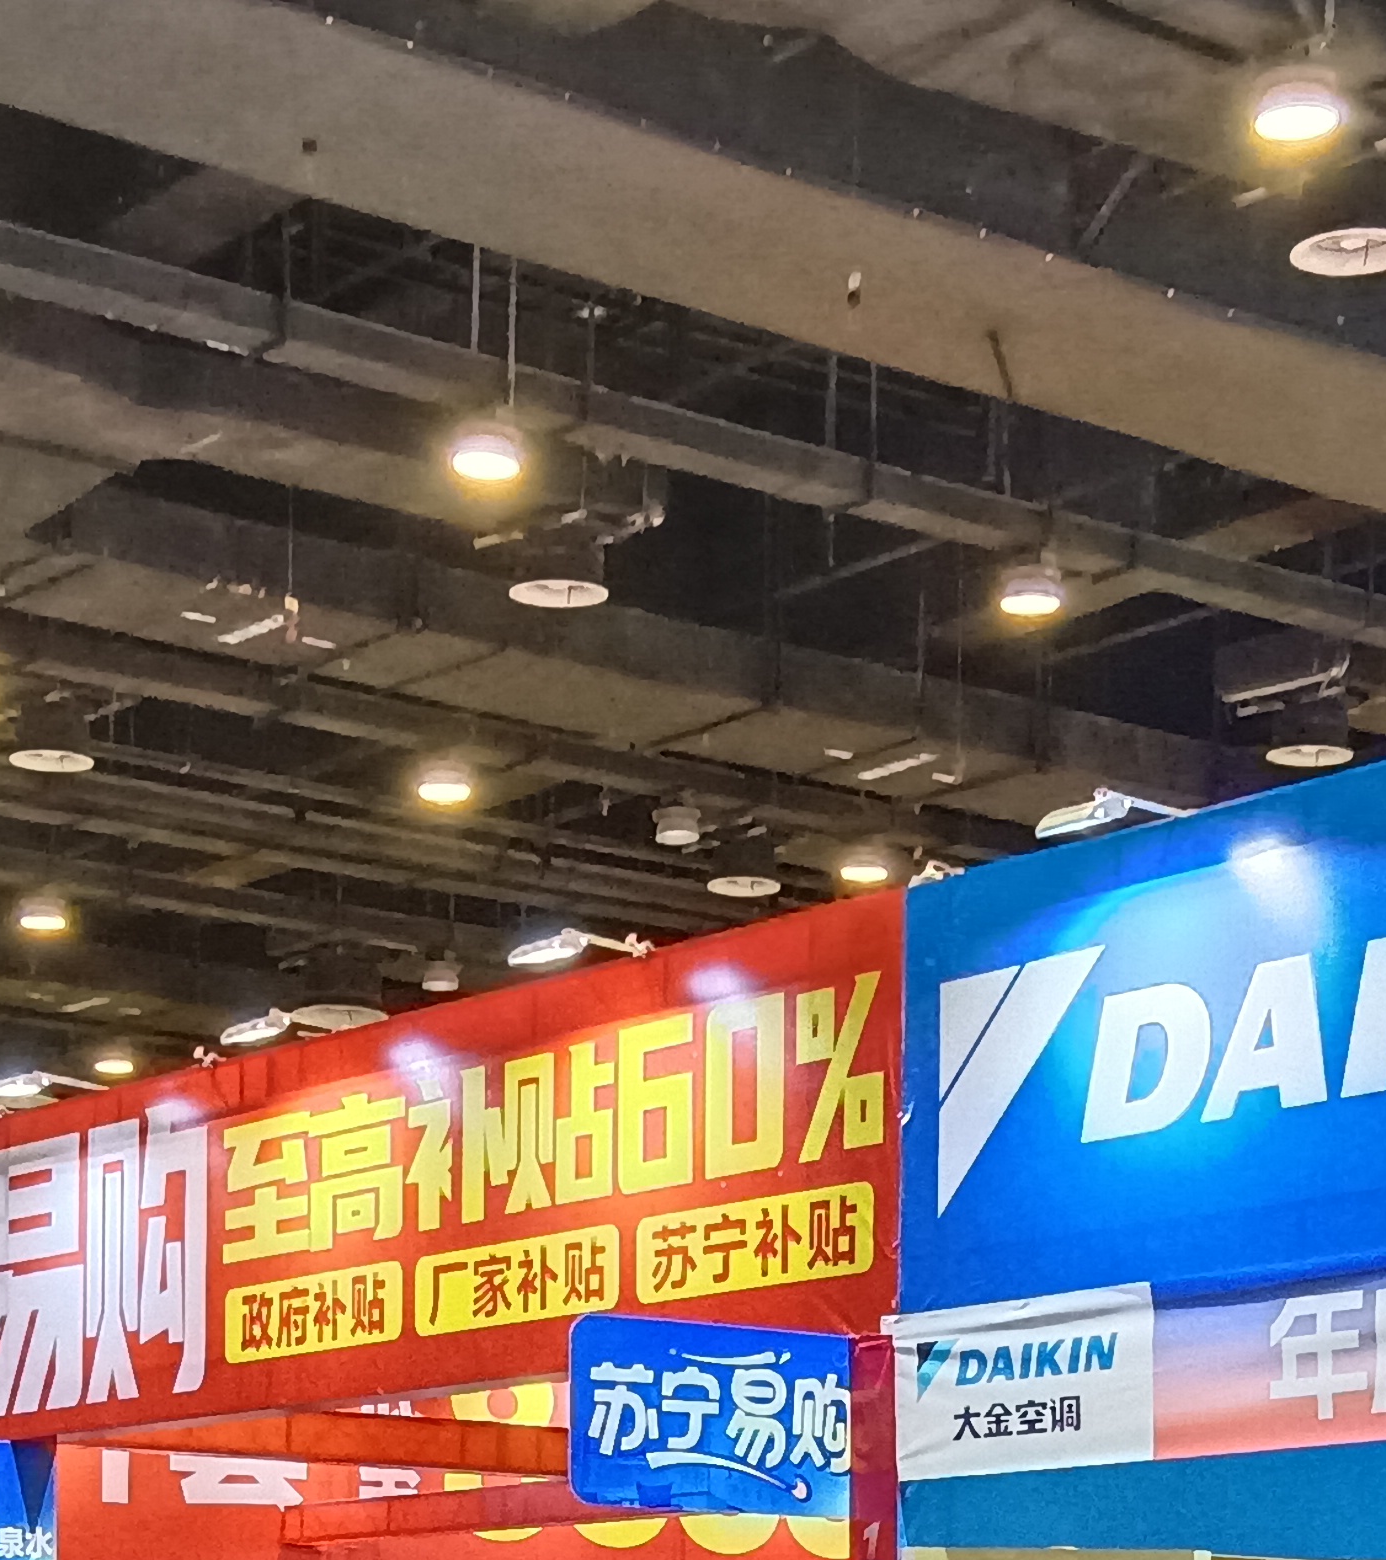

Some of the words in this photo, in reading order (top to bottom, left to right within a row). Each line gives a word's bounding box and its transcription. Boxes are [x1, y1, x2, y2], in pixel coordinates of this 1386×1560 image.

[222, 971, 884, 1264] 至高补贴60%
[240, 1270, 386, 1351] 政府补贴
[427, 1237, 607, 1327] 厂家补贴
[650, 1195, 858, 1292] 苏宁补贴
[955, 1332, 1118, 1387] DAIKIN
[587, 1361, 851, 1473] 苏宁易购
[953, 1395, 1081, 1441] 大金空调
